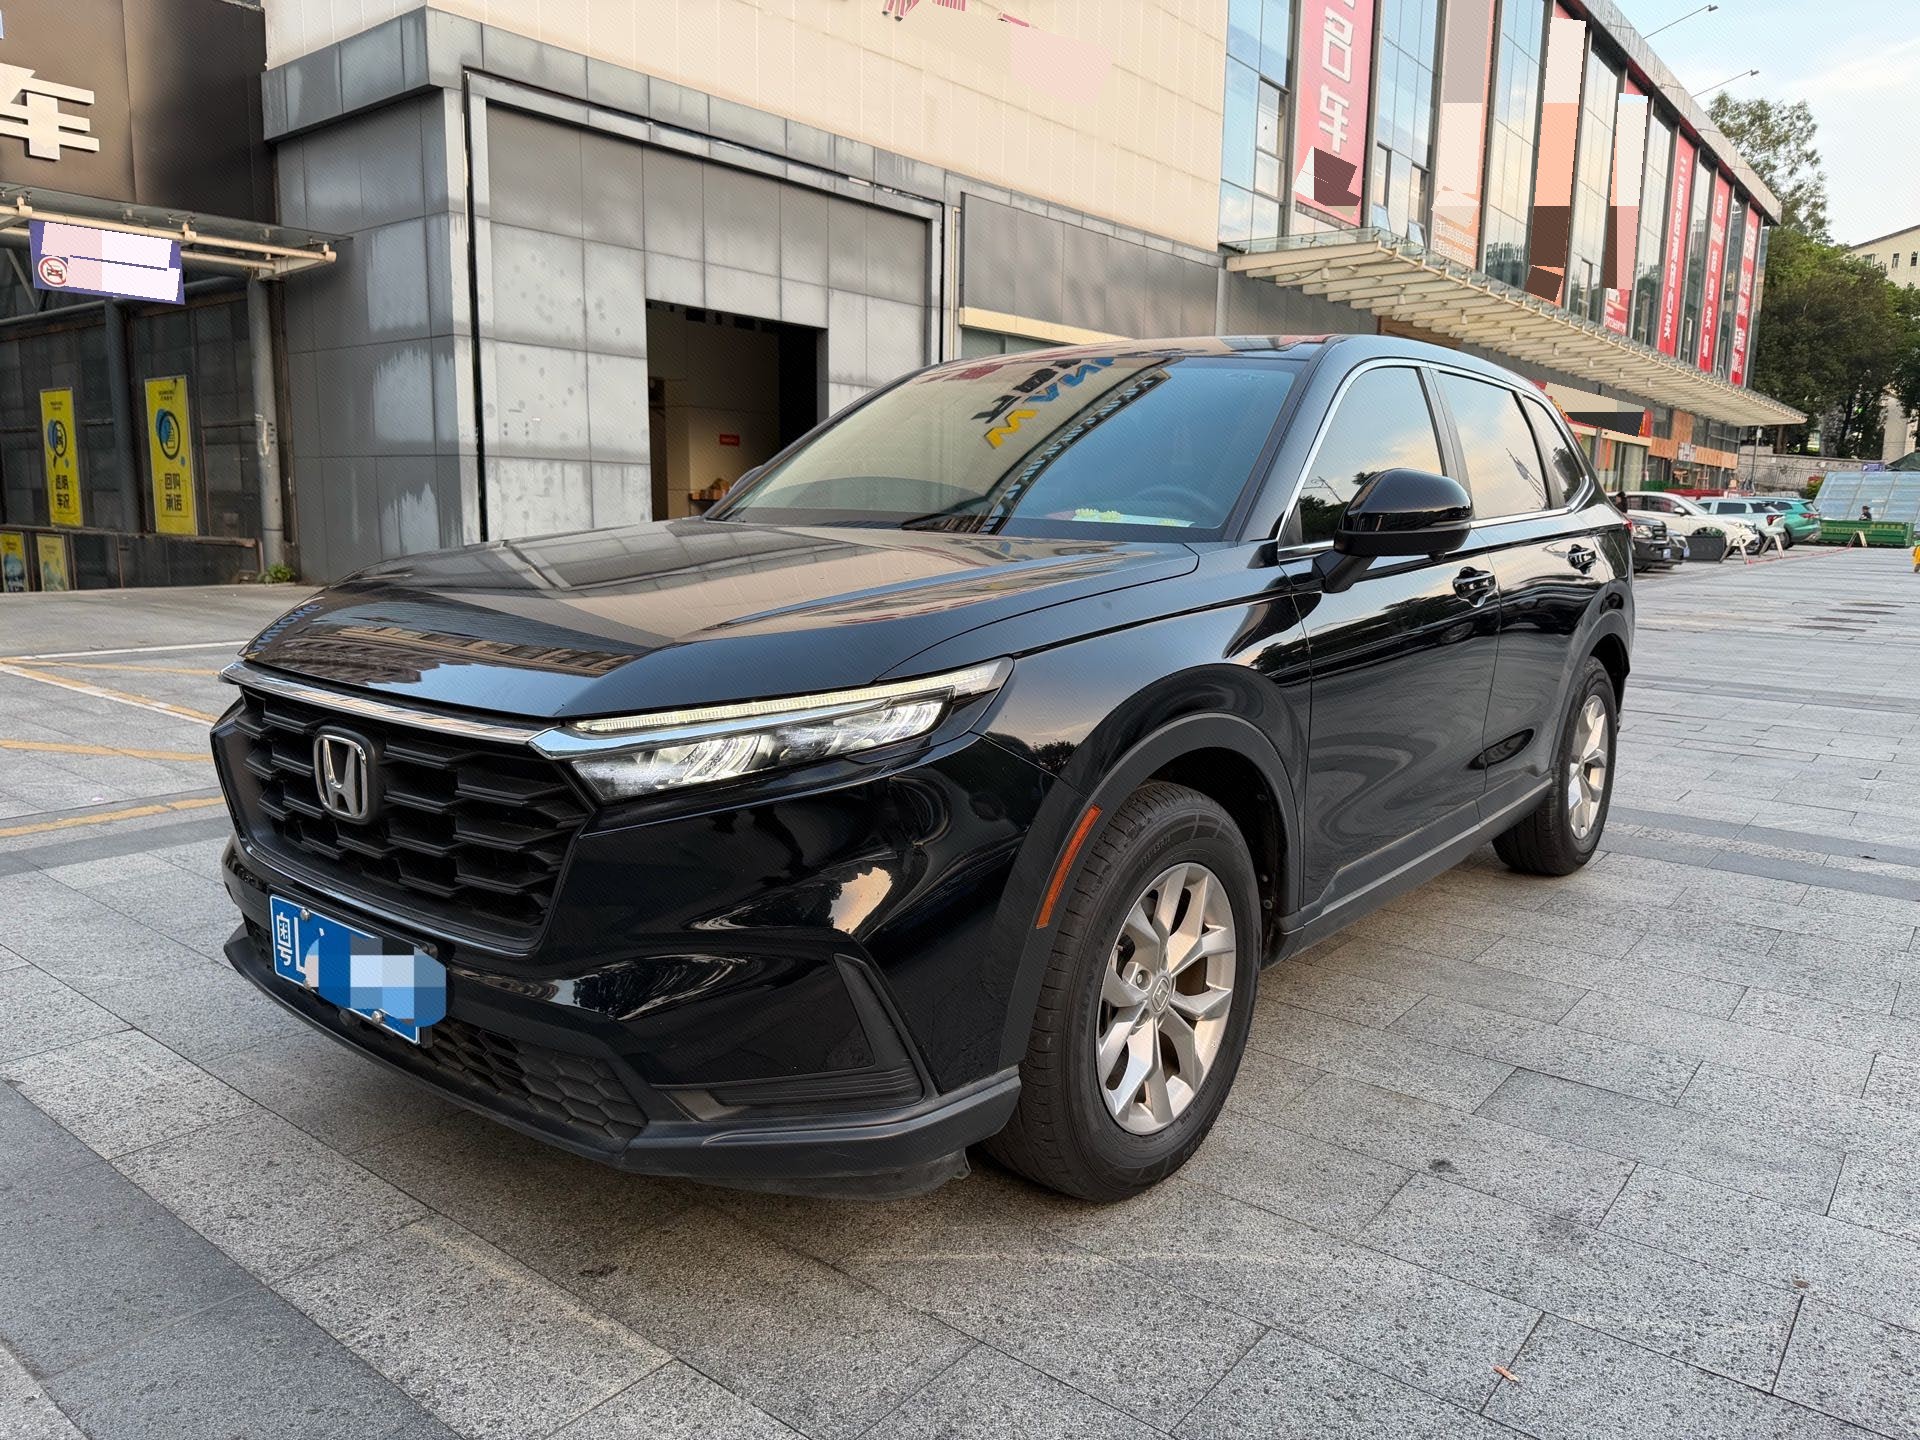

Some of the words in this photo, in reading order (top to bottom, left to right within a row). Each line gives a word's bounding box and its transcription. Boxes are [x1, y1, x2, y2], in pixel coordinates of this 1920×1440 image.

[1319, 0, 1354, 153] 名车
[0, 63, 99, 160] 车
[164, 473, 181, 490] 回购
[56, 493, 70, 509] 车况
[165, 493, 182, 511] 承诺
